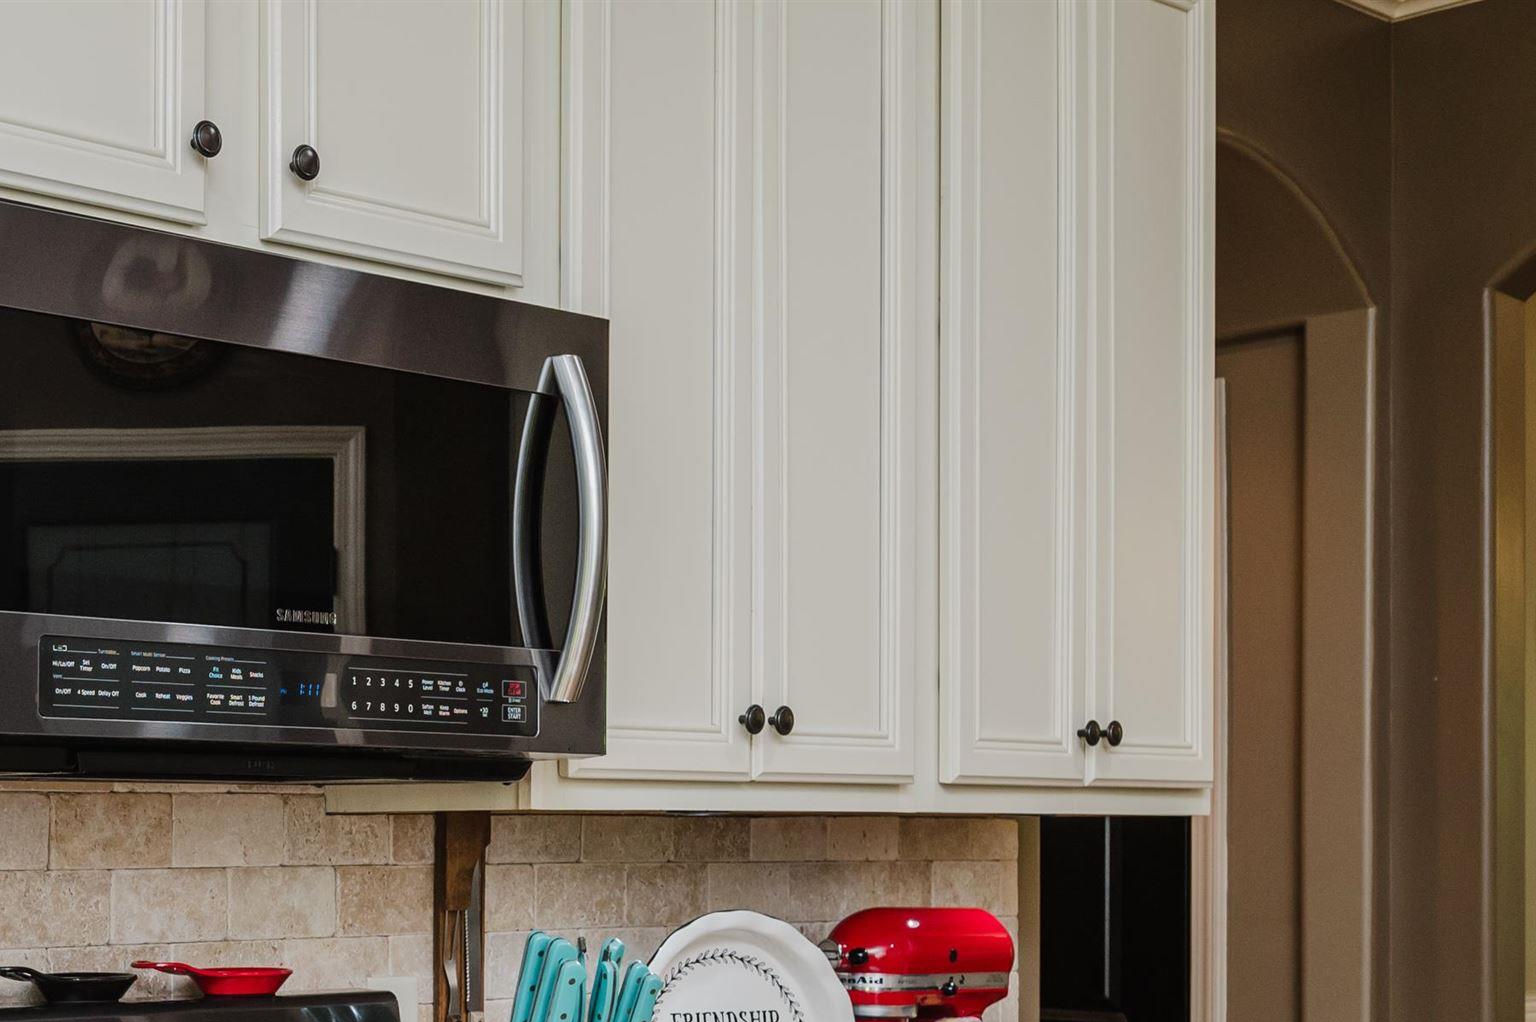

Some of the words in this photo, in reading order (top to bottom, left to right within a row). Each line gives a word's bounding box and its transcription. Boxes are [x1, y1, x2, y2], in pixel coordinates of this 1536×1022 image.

[276, 608, 337, 625] SAMSUNG
[132, 664, 151, 672] Popcorn
[352, 676, 357, 686] 1
[366, 677, 372, 687] 2
[380, 677, 386, 687] 3
[394, 679, 400, 688] 4
[408, 680, 414, 689] 5
[351, 701, 357, 710] 6
[366, 701, 372, 711] 7
[380, 702, 386, 712] 8
[394, 703, 400, 713] 9
[408, 704, 414, 713] 0
[840, 976, 883, 984] enAid
